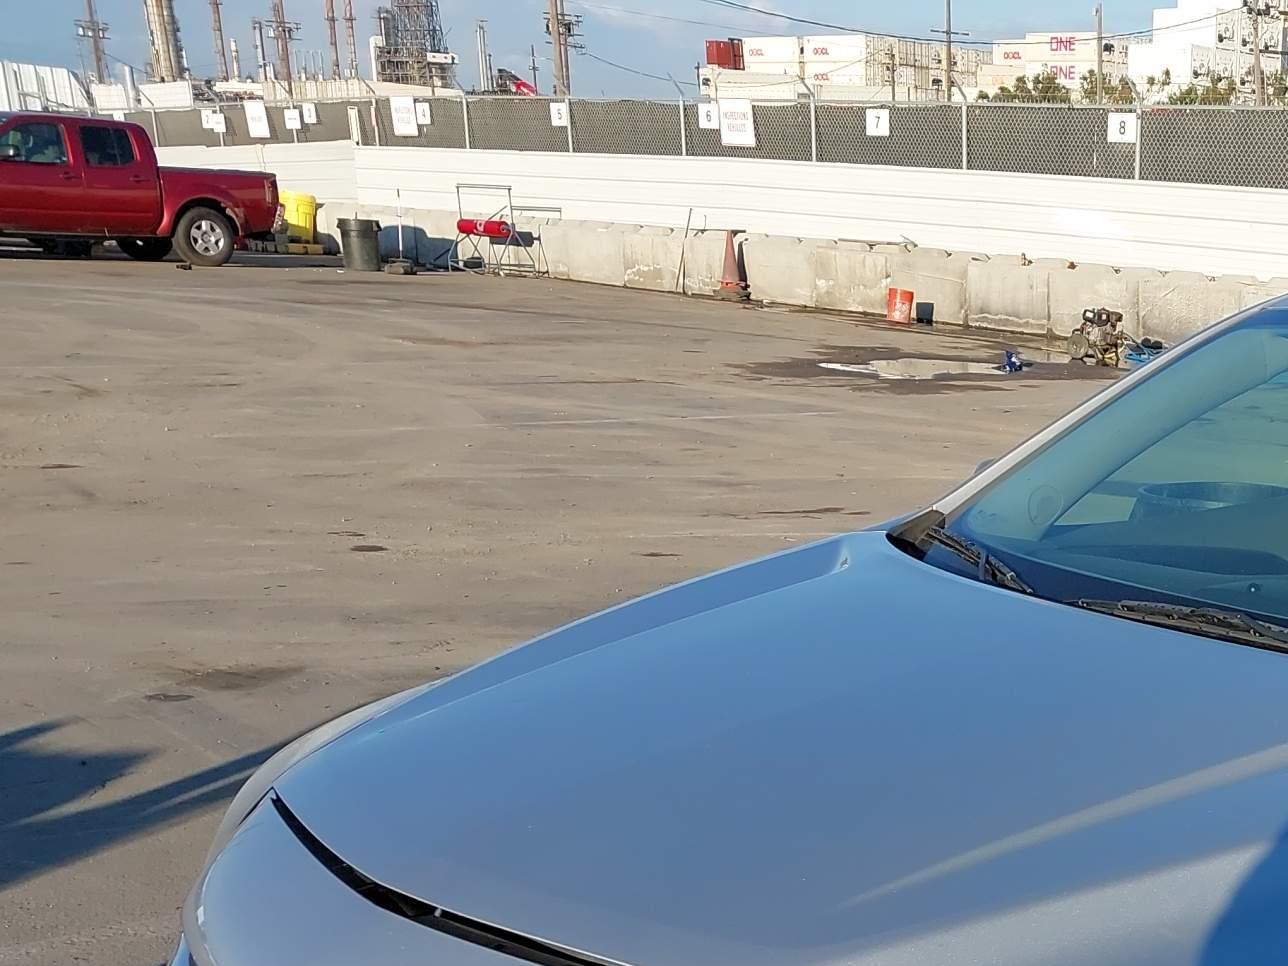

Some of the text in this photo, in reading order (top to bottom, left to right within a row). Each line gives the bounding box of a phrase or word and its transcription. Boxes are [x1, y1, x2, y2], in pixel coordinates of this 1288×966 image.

[1050, 36, 1076, 51] ONE
[557, 108, 562, 120] 5
[706, 110, 712, 122] 6
[874, 115, 881, 128] 7
[1119, 120, 1126, 135] 8
